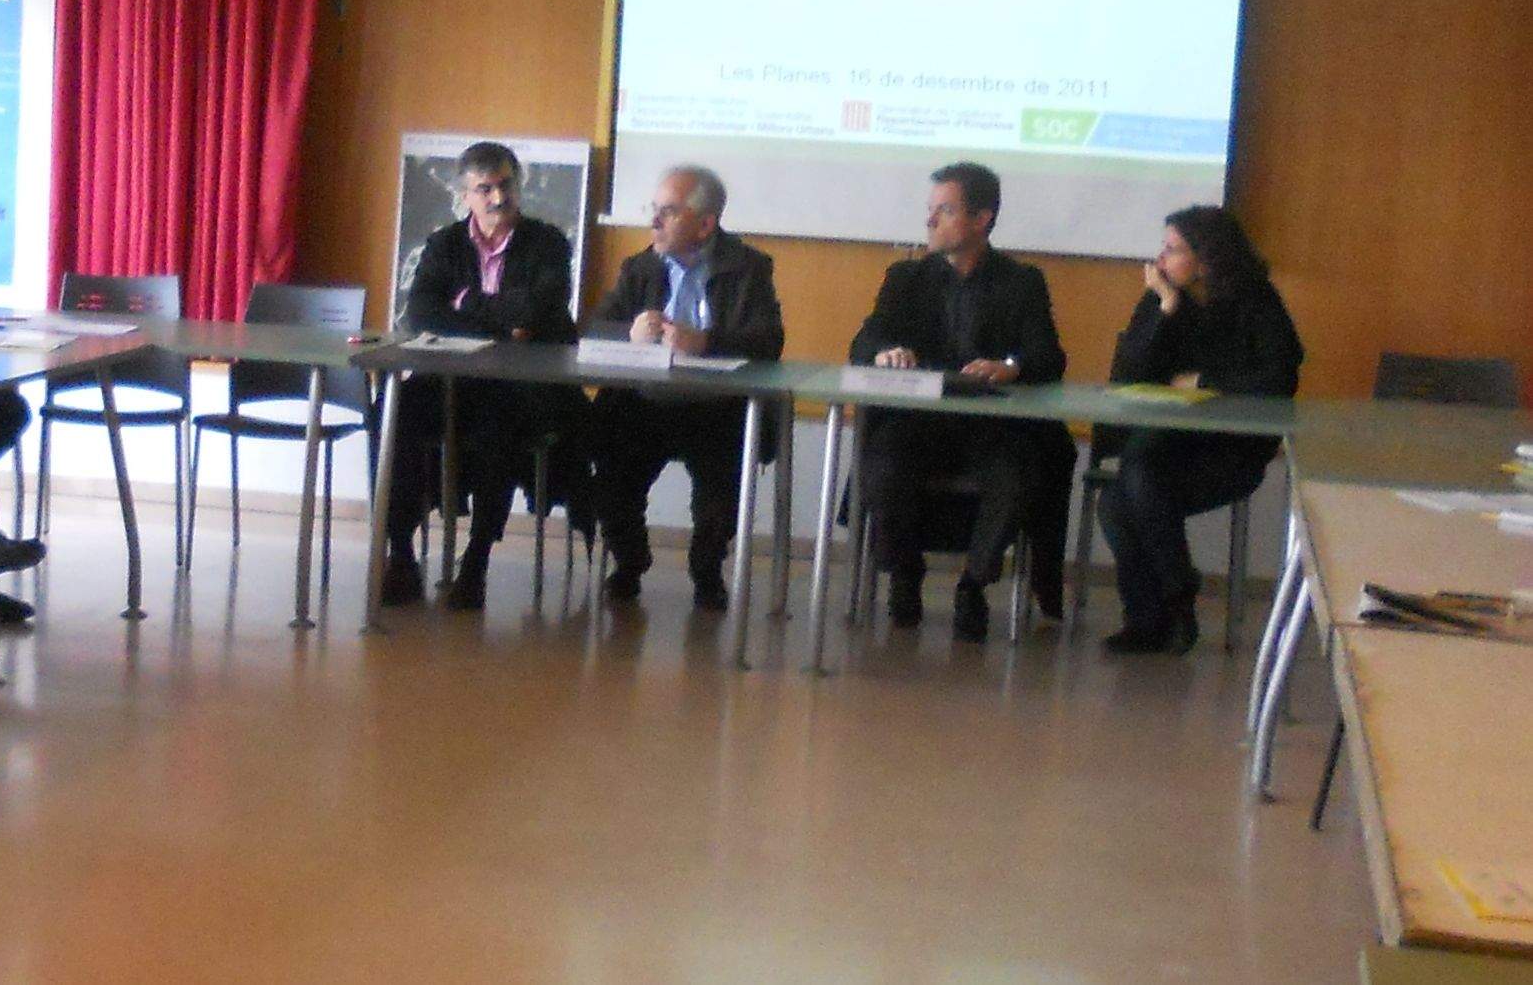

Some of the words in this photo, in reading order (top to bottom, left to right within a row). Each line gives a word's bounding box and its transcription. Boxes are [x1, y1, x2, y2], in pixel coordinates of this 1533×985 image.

[719, 64, 754, 82] Les
[879, 70, 905, 88] de
[912, 72, 1016, 93] desembre
[1024, 77, 1051, 95] de
[1058, 77, 1109, 99] 2011
